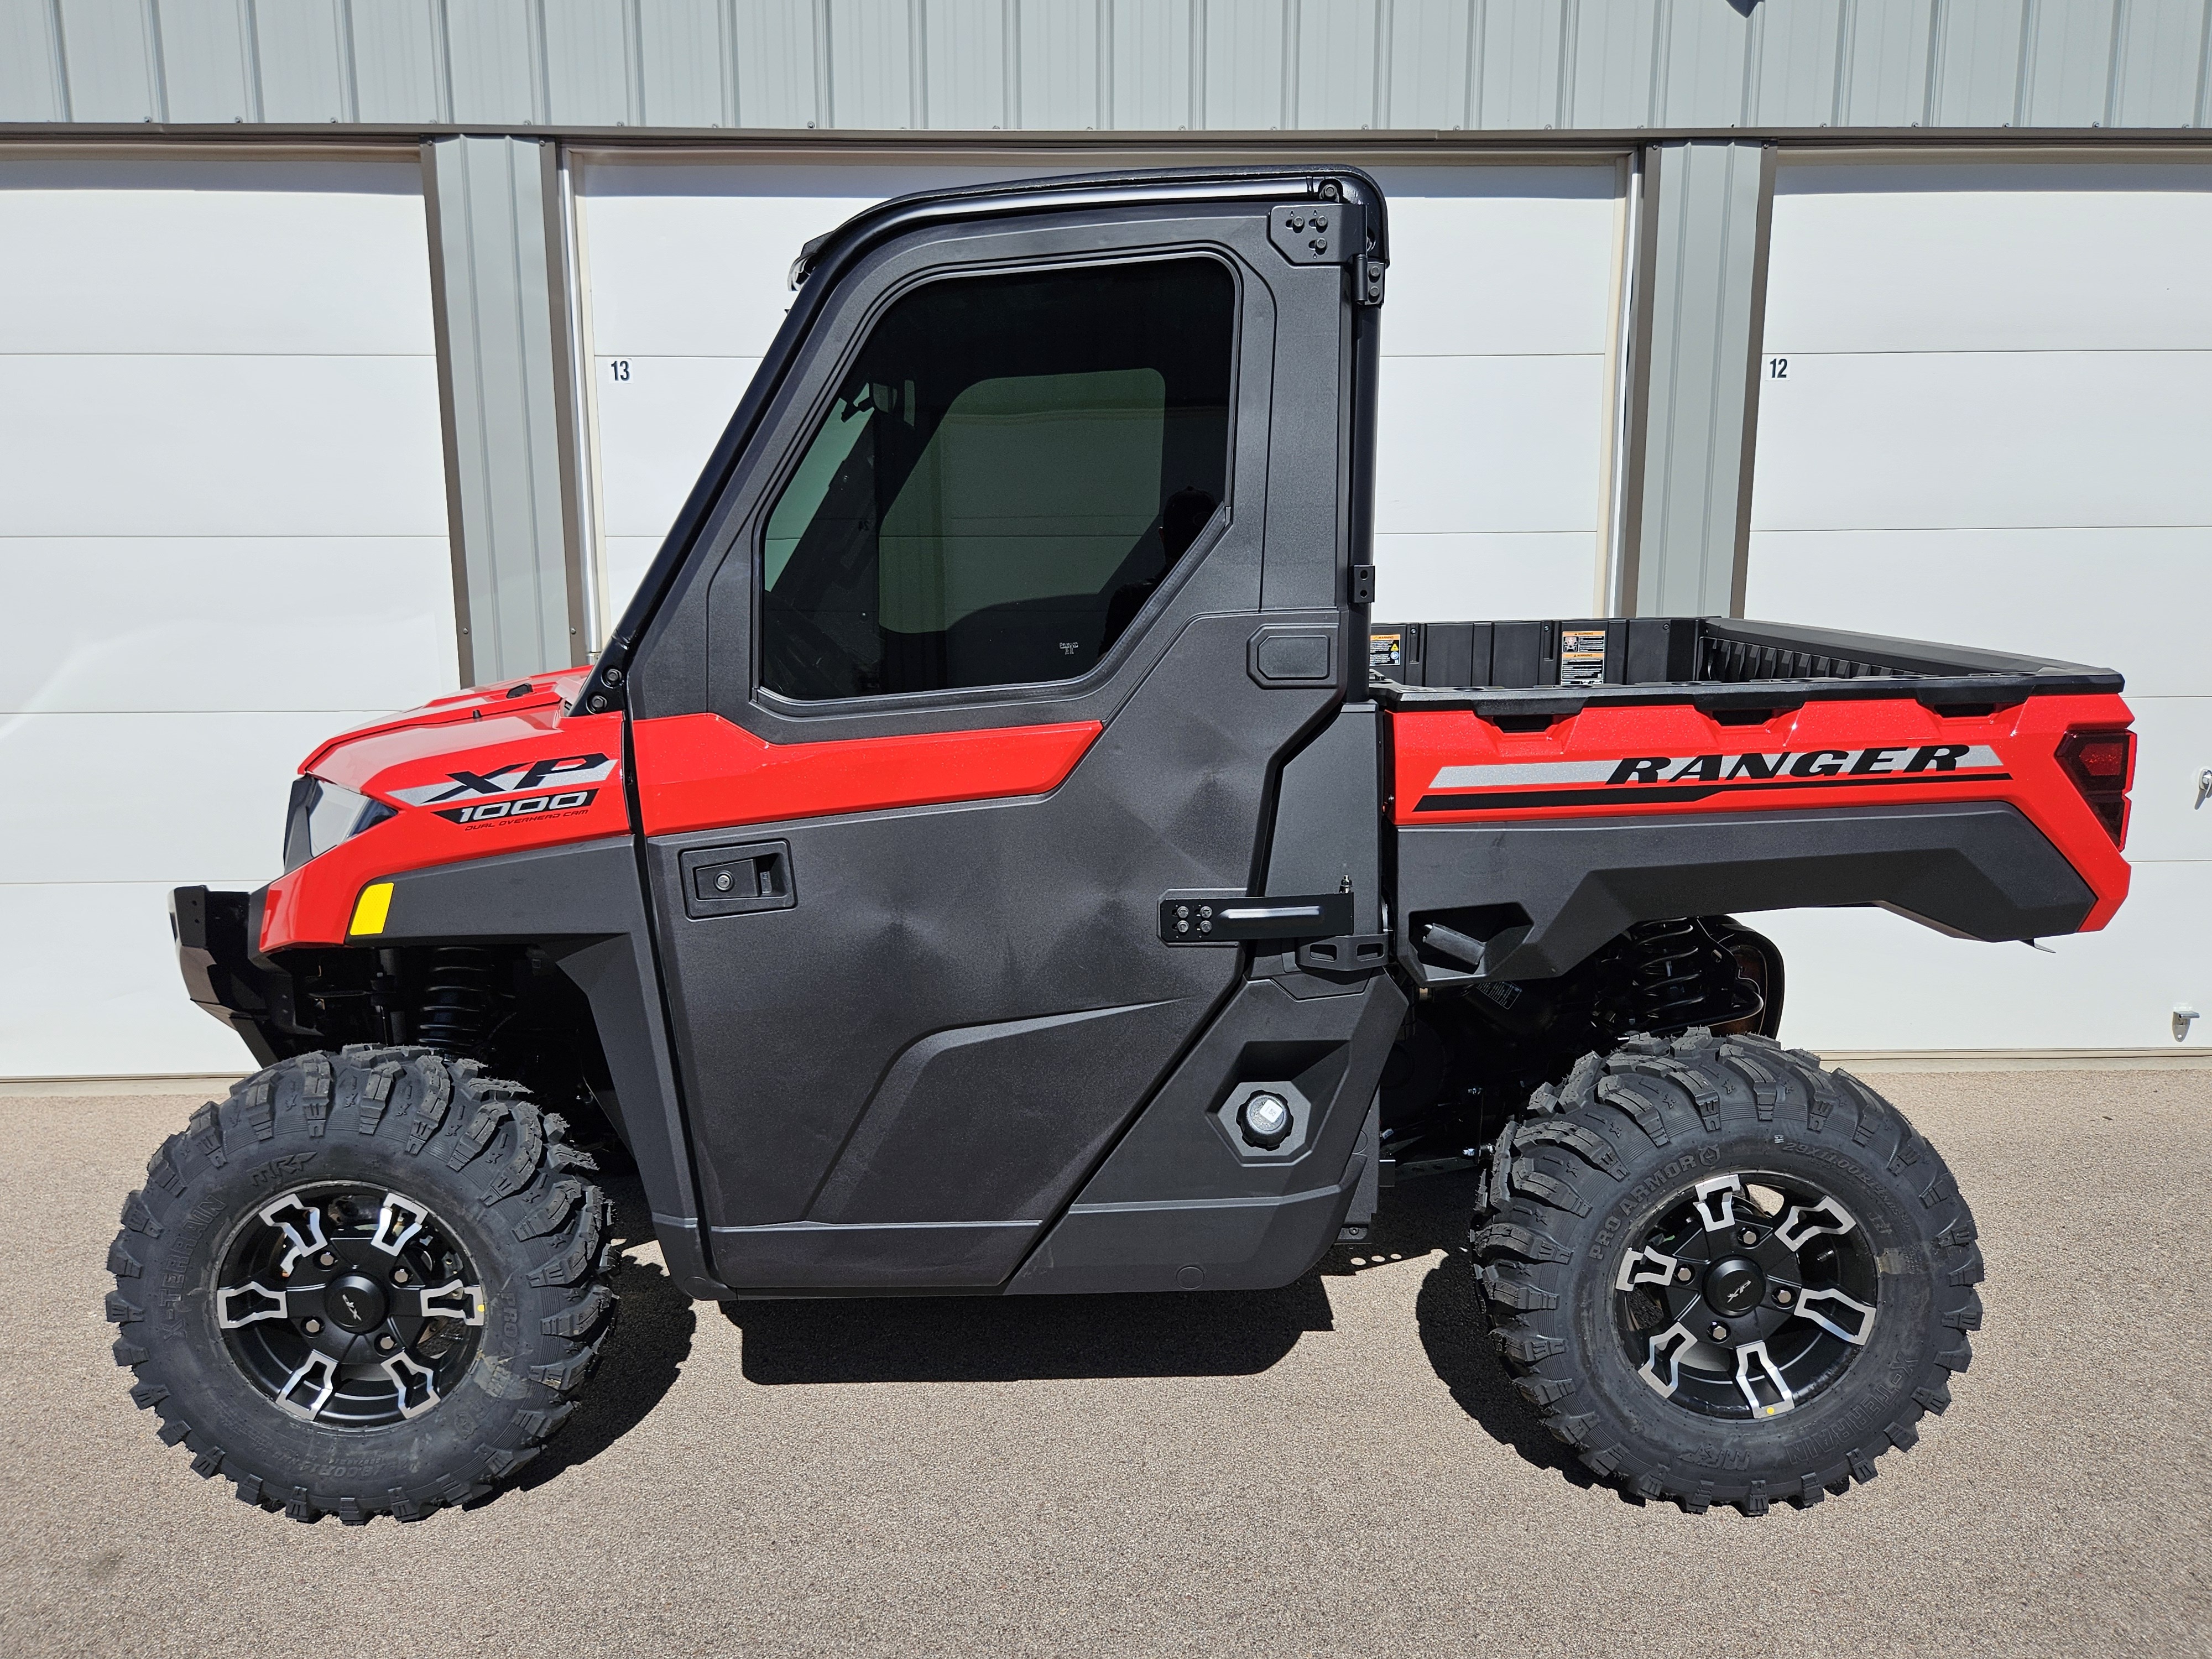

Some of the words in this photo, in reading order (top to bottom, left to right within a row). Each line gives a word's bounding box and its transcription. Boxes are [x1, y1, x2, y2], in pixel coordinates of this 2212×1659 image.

[611, 361, 630, 381] 13
[1770, 358, 1787, 378] 12
[423, 753, 609, 804] XP
[1604, 744, 1970, 785] RANGER
[460, 791, 588, 823] 1000
[498, 813, 561, 826] OVERHEAD
[563, 809, 589, 817] CAM
[1588, 1215, 1622, 1260] PRO
[1619, 1154, 1697, 1216] ARMOR
[159, 1194, 227, 1342] X-TERRAIN
[342, 1294, 362, 1321] XP
[1727, 1280, 1752, 1303] XP
[500, 1292, 518, 1338] PRO
[1784, 1350, 1919, 1465] X-TERRAIN
